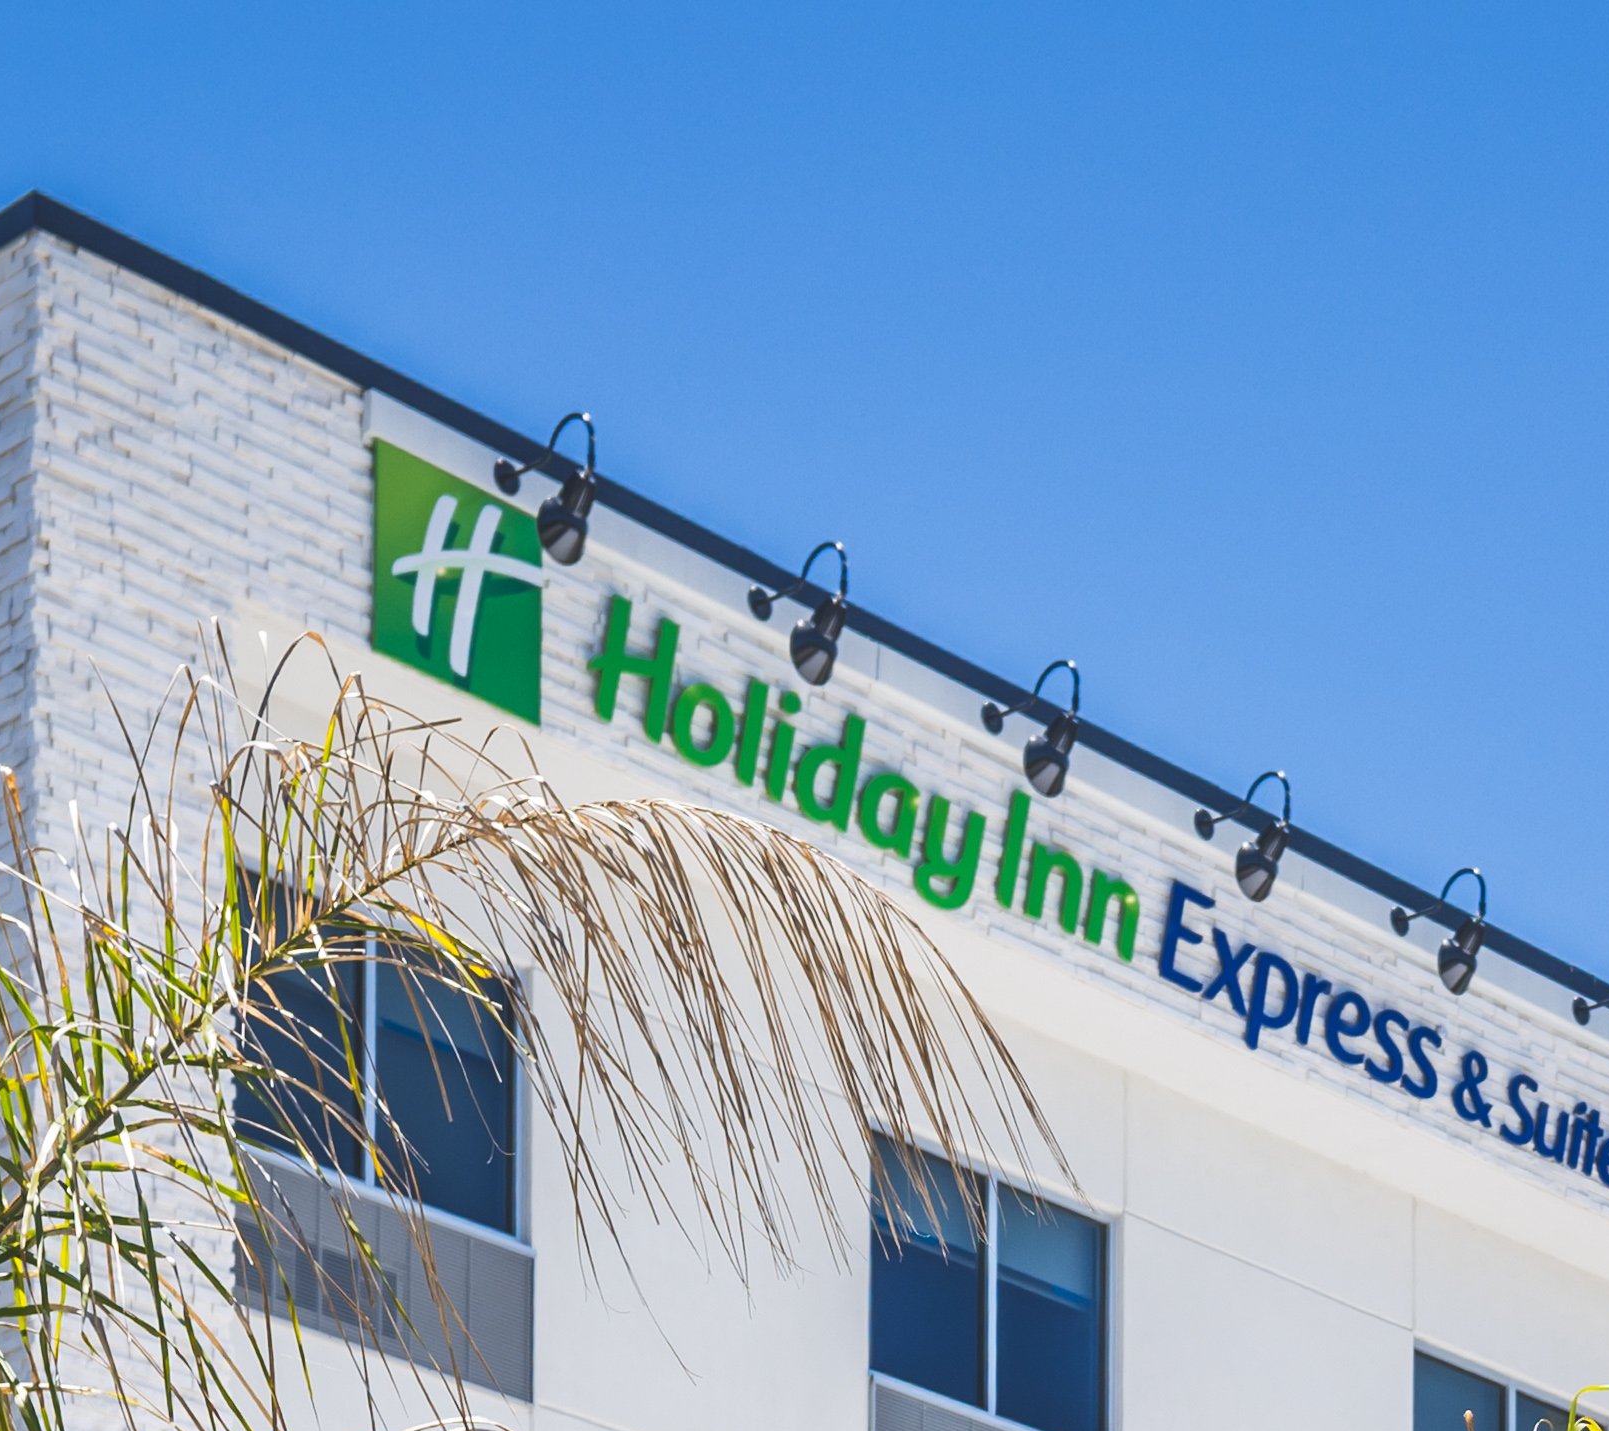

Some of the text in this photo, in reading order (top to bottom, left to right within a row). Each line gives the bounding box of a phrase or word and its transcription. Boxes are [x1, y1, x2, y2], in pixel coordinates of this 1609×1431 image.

[588, 594, 987, 911] Holiday
[995, 789, 1141, 962] Inn
[1158, 878, 1443, 1100] Express
[1451, 1050, 1493, 1129] &
